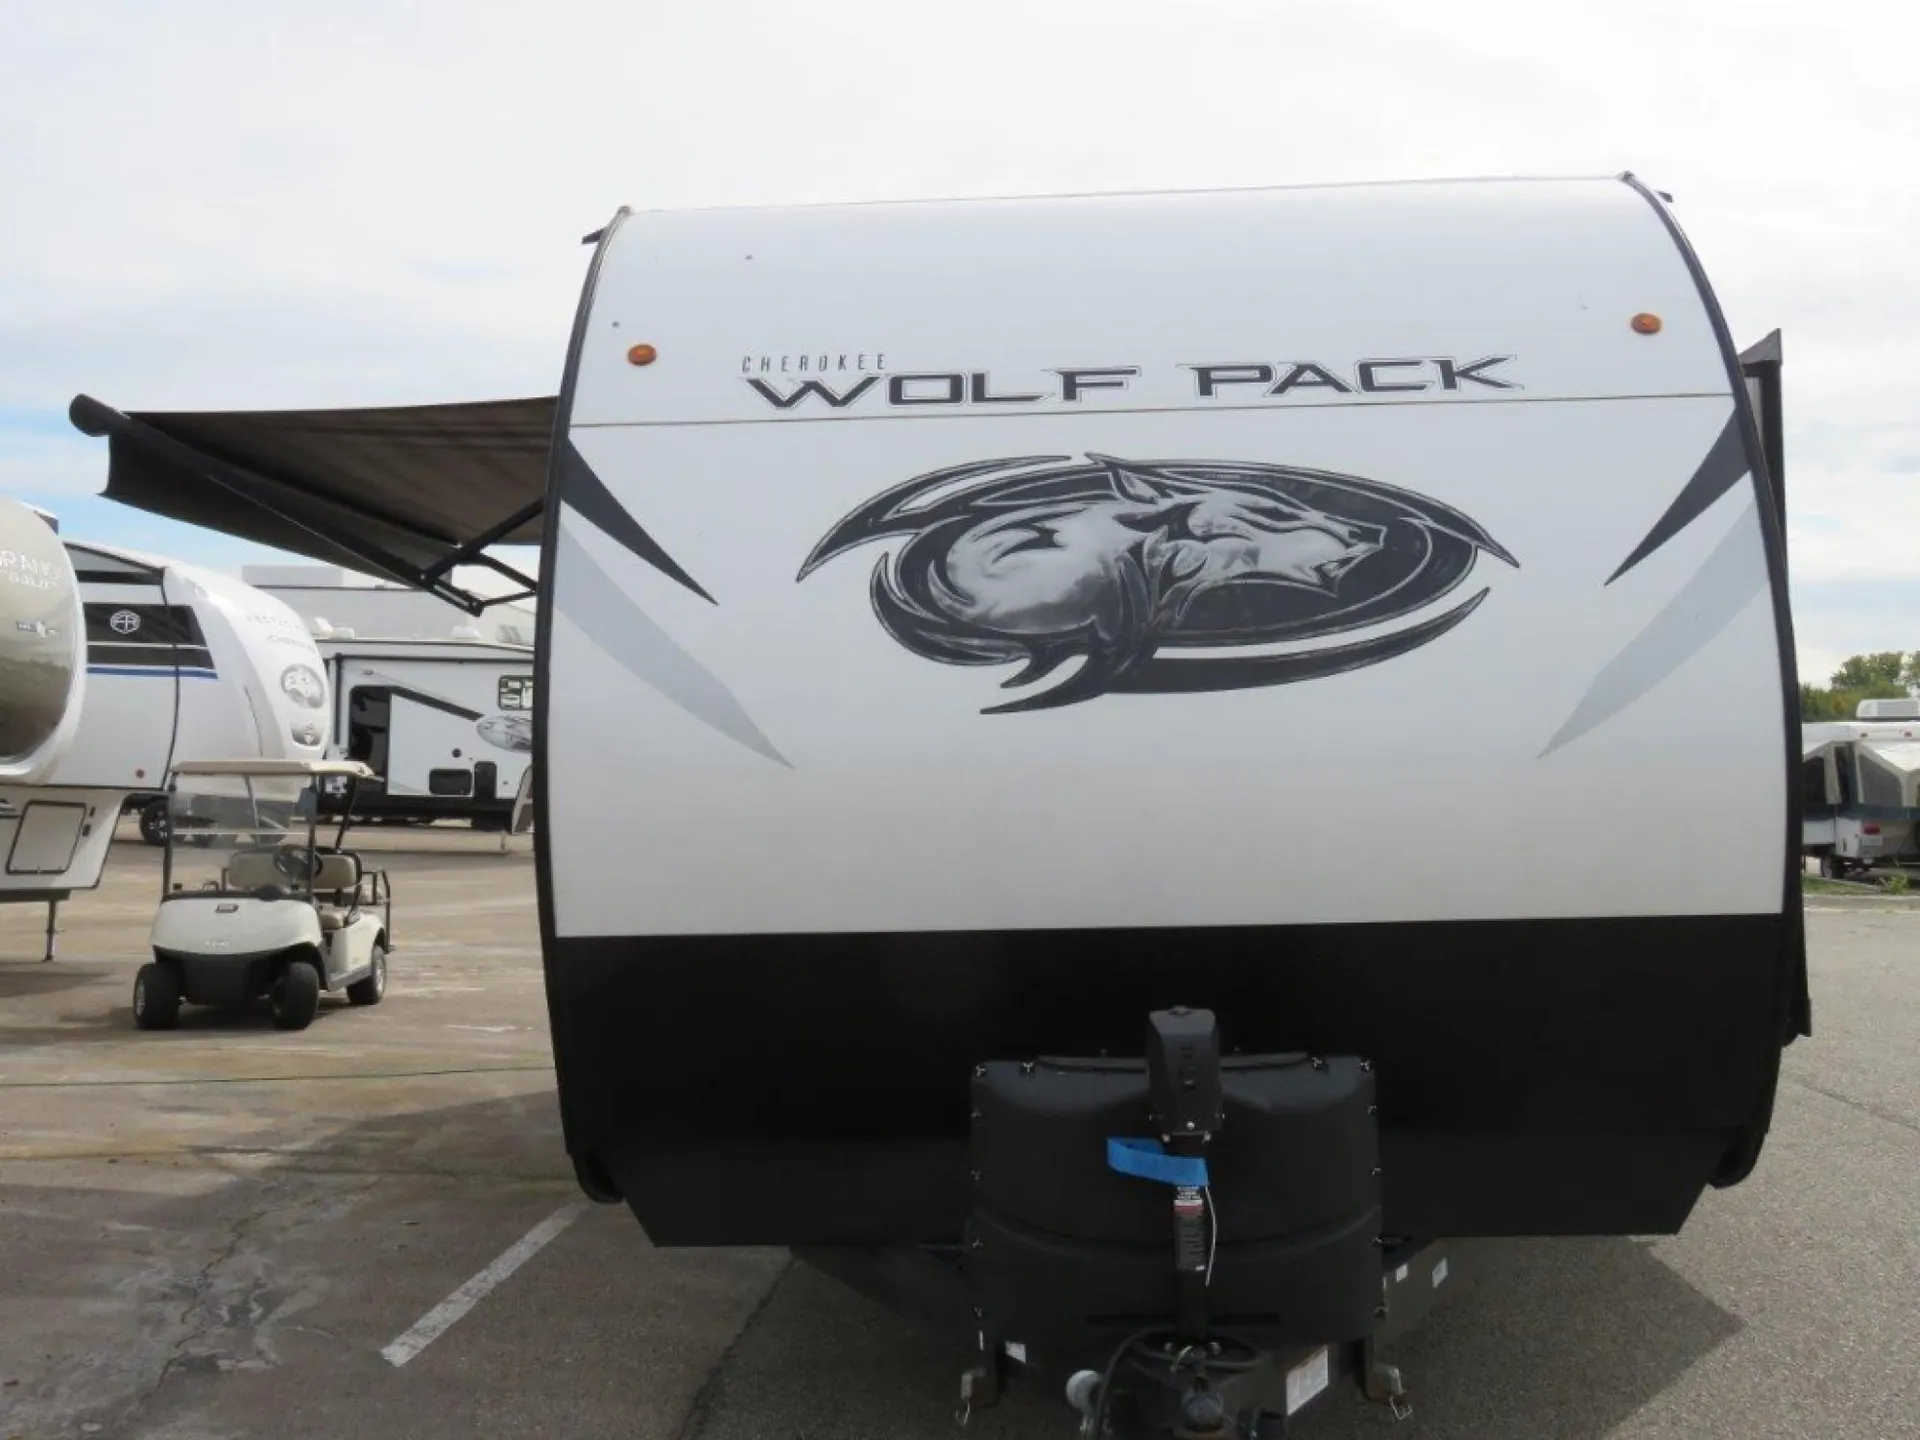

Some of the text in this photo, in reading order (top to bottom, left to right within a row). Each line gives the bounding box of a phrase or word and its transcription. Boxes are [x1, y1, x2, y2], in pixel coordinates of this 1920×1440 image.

[738, 354, 1523, 410] WOLF PACK
[742, 353, 885, 373] CHEROKEE
